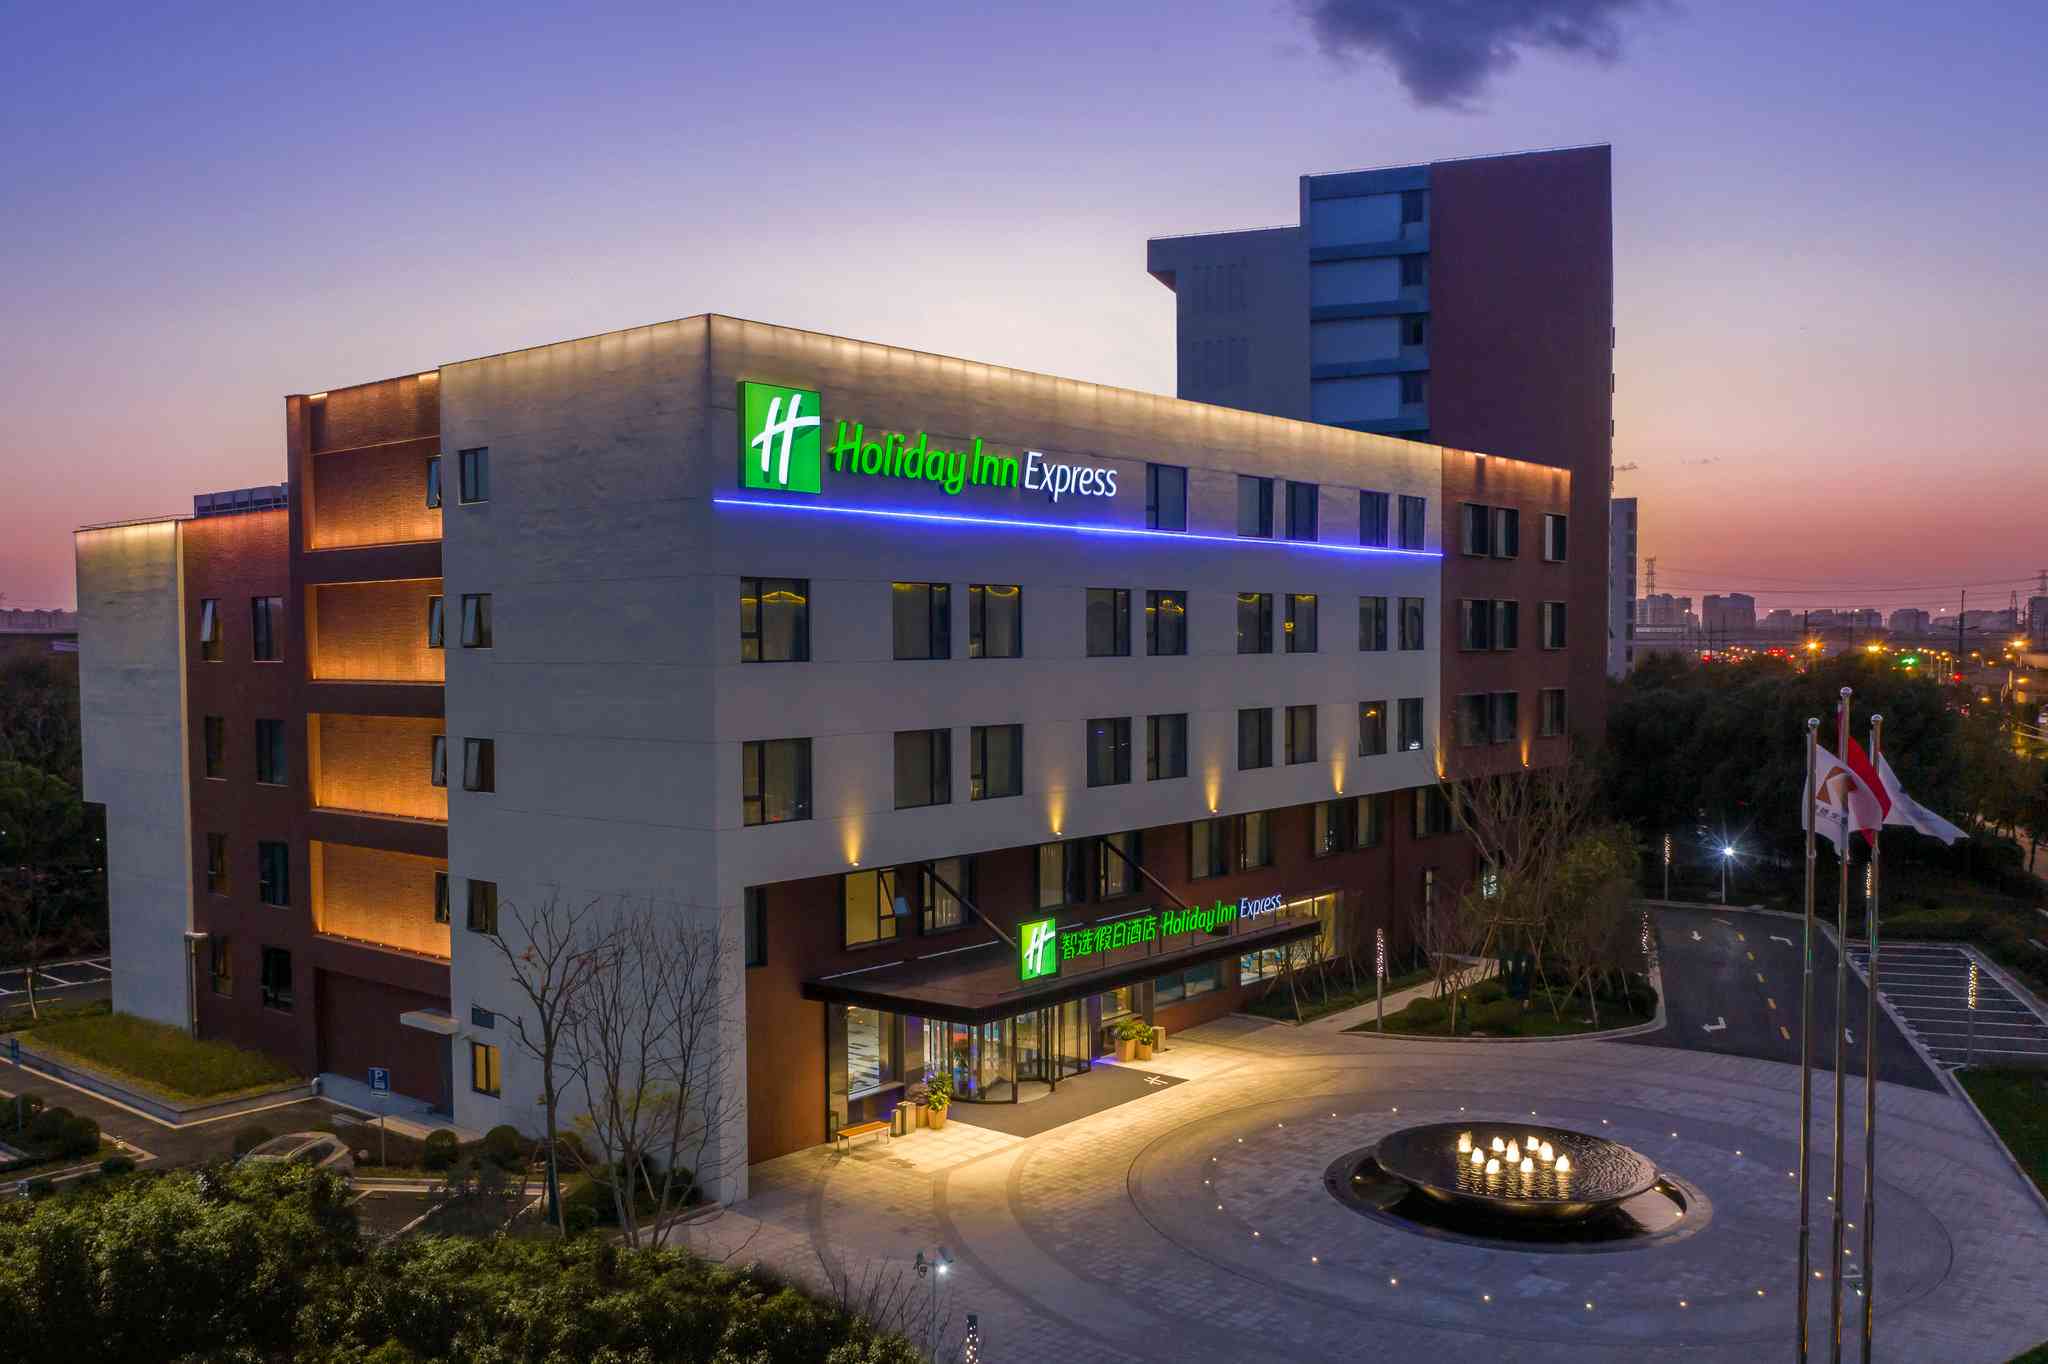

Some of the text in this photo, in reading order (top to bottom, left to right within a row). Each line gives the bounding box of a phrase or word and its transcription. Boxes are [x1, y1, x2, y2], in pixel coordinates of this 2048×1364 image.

[828, 419, 1118, 502] Holiday Inn Express
[1062, 894, 1282, 960] 智选假日酒店 Holiday Inn Express
[375, 1070, 384, 1080] P
